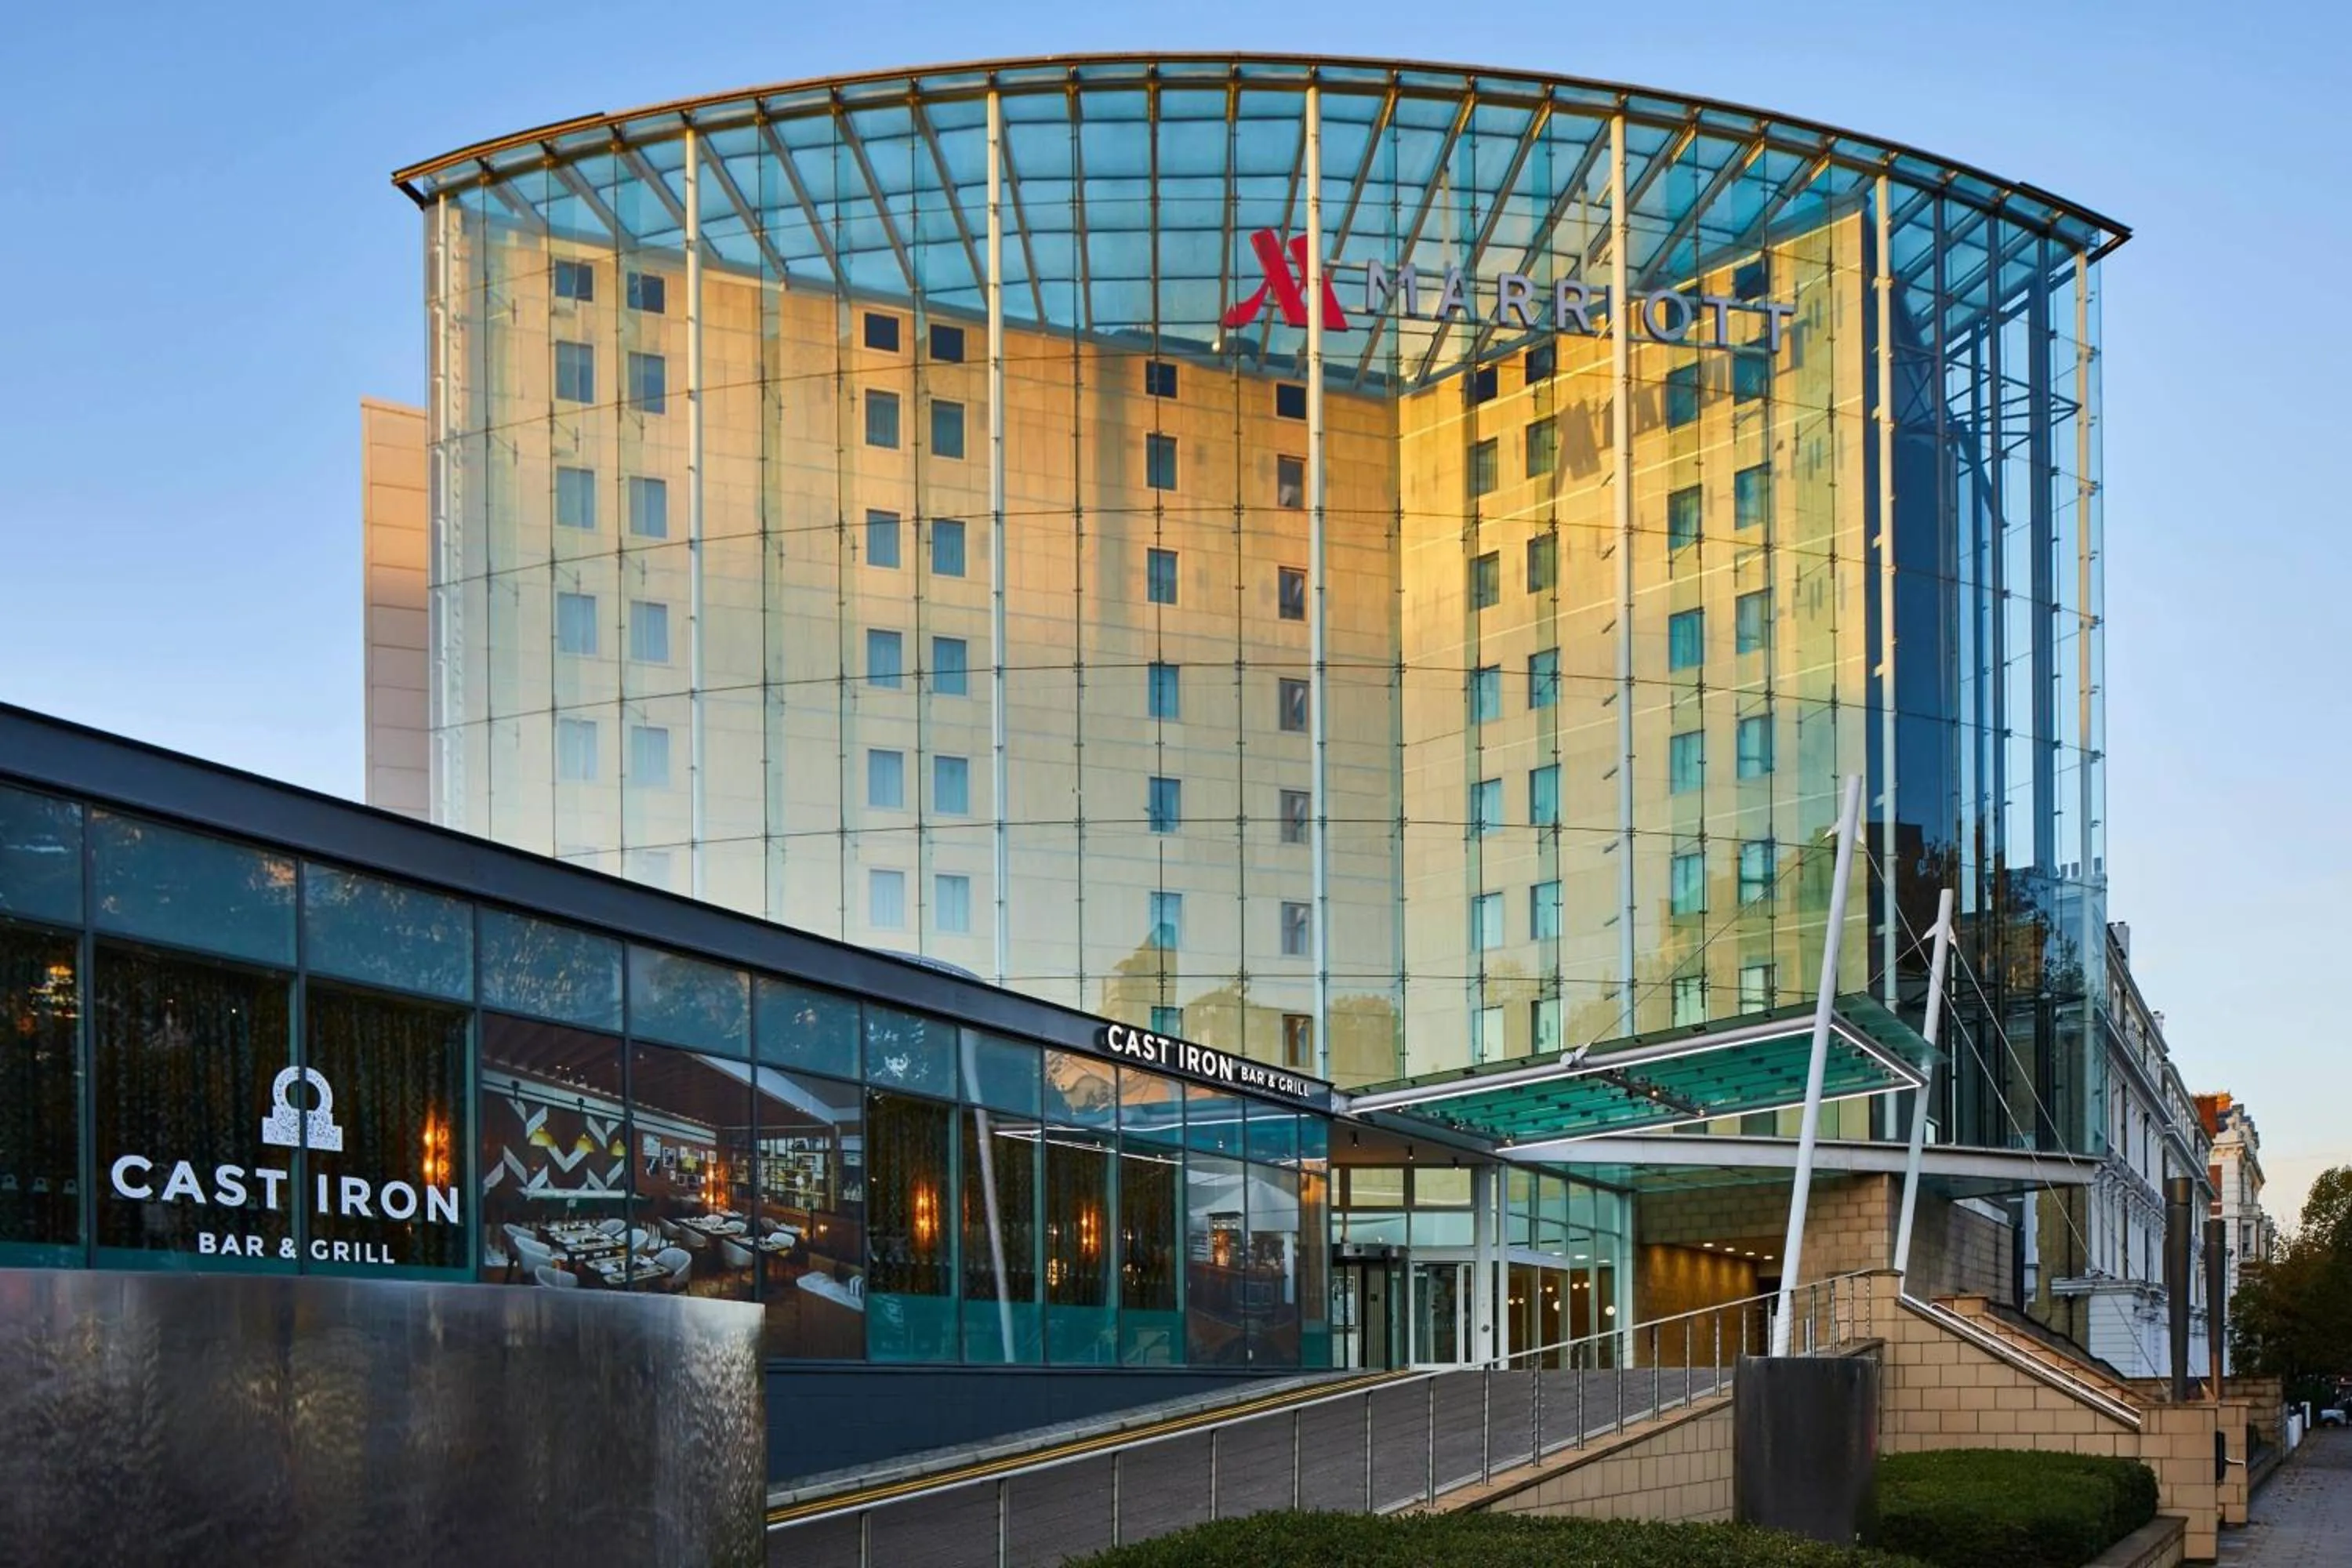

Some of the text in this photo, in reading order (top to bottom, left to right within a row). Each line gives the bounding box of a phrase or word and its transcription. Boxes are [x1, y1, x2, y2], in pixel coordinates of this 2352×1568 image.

[1108, 1025, 1309, 1097] CAST IRON BAR & GRILL
[111, 1155, 459, 1224] CAST IRON
[198, 1232, 395, 1265] BAR & GRILL
